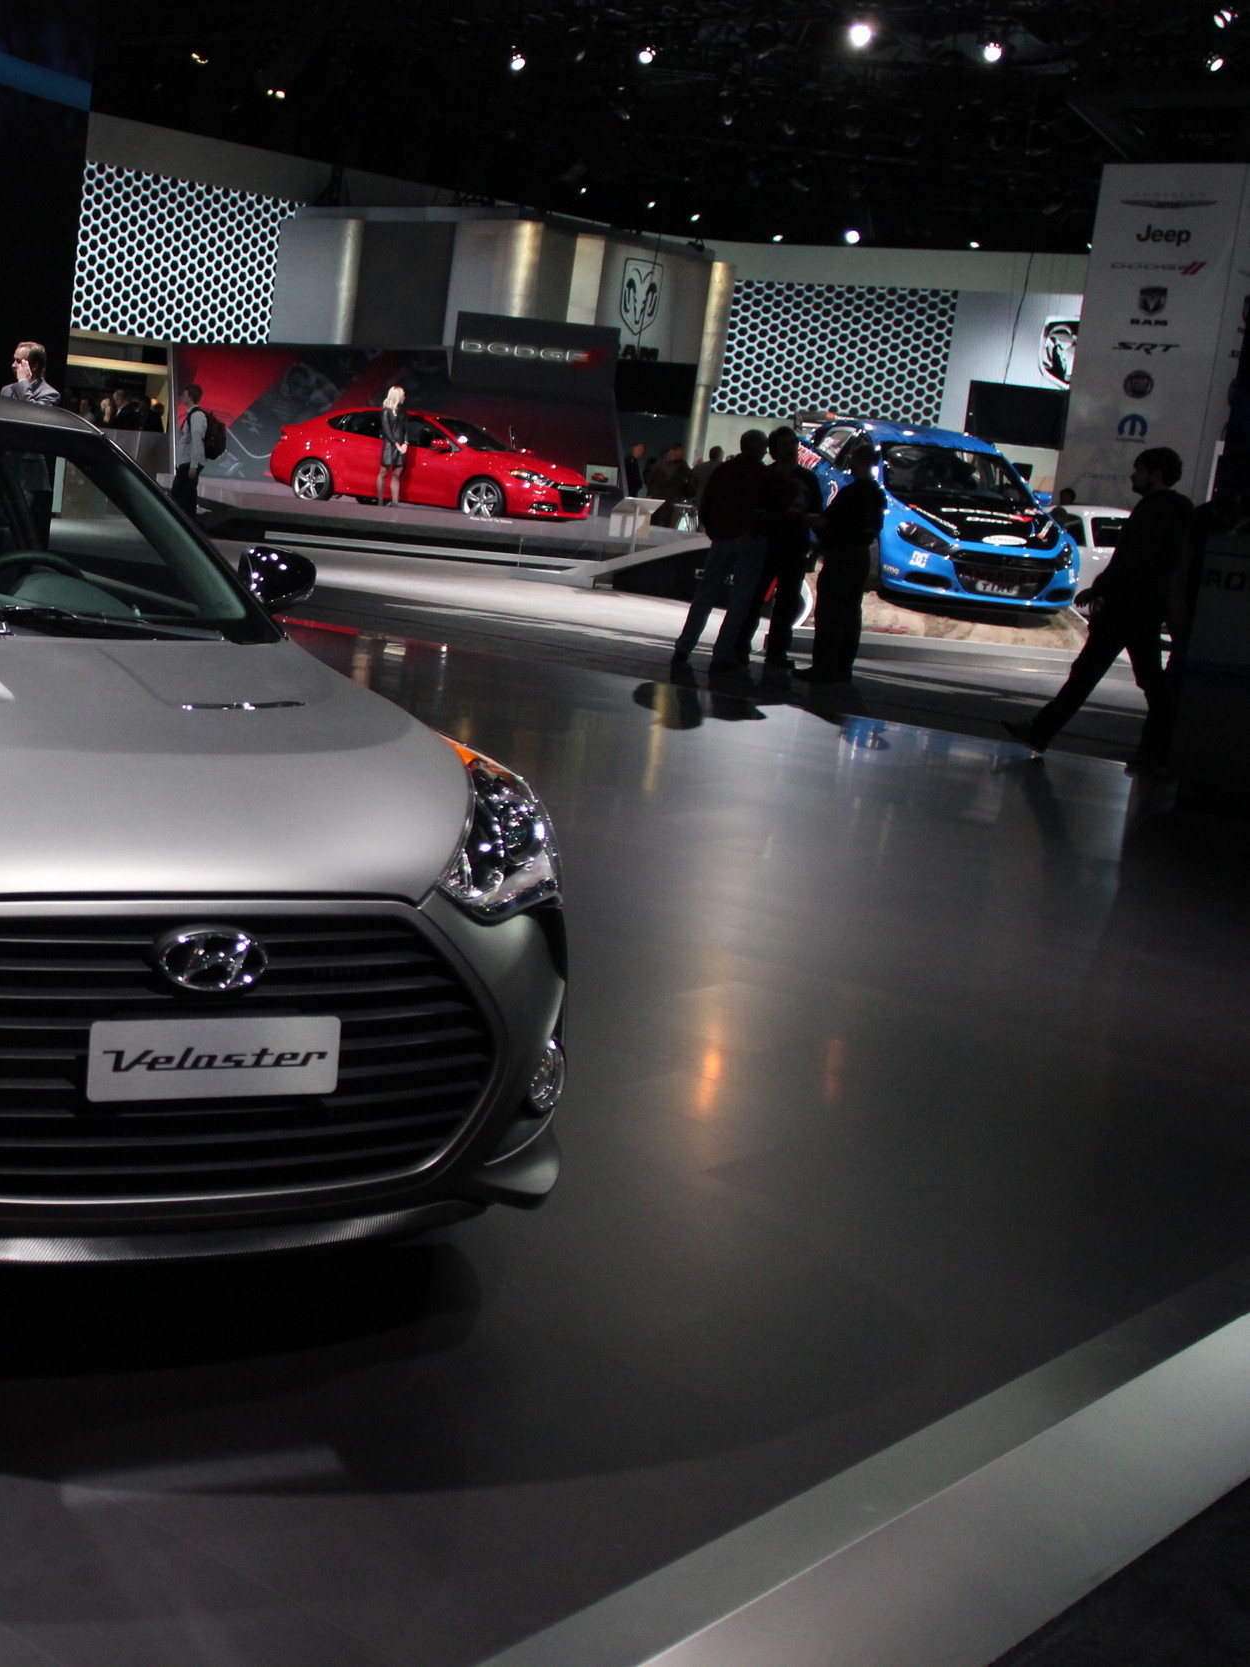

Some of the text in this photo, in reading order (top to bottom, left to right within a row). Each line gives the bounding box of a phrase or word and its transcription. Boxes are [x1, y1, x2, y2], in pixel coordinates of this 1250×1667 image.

[1136, 224, 1191, 246] Jeep
[1130, 318, 1168, 327] RAM
[461, 339, 590, 363] DODGE
[617, 344, 659, 361] AM
[1111, 341, 1181, 355] SRT
[103, 1047, 328, 1072] Veloster
